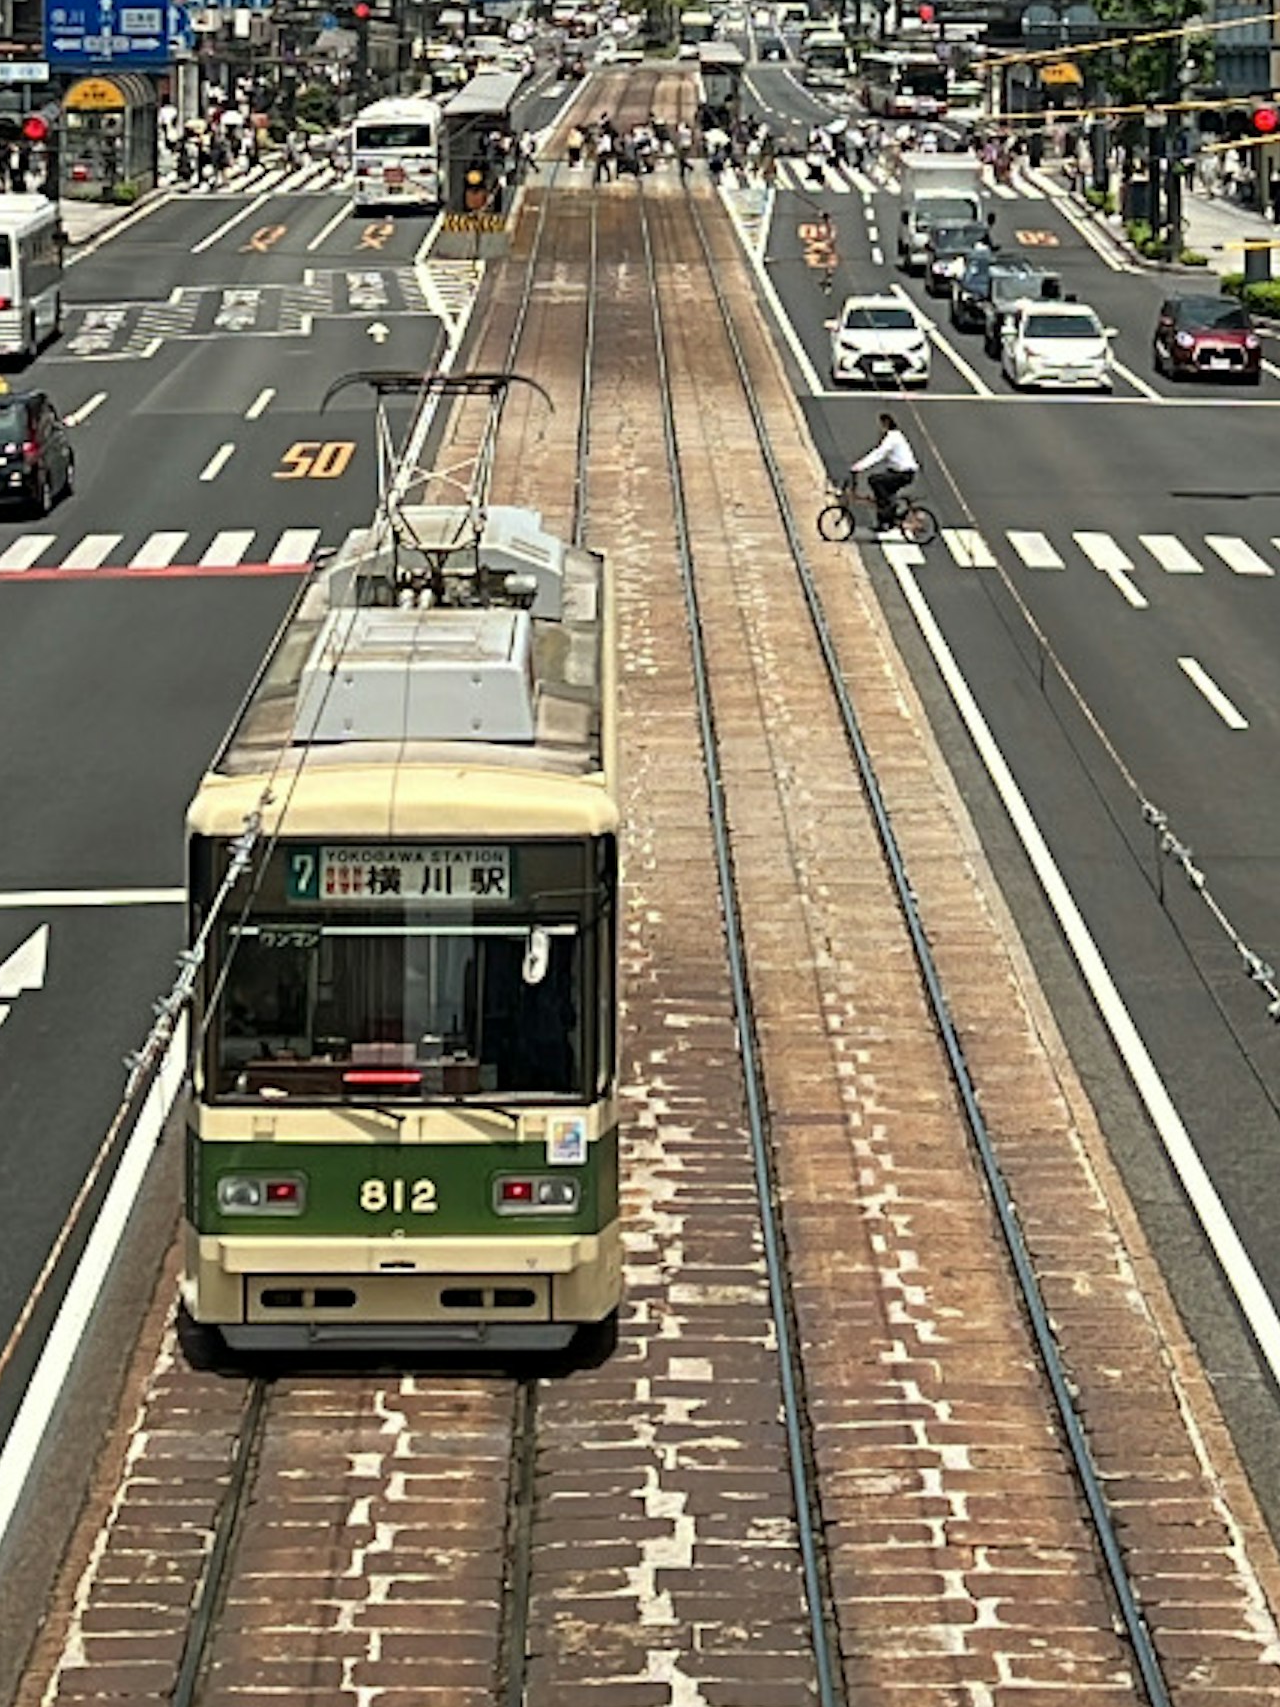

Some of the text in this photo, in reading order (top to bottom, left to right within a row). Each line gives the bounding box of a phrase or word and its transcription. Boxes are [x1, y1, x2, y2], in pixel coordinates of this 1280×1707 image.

[271, 441, 357, 479] 50
[293, 854, 314, 893] 7
[326, 849, 504, 863] YOKOGAWA STATION
[365, 864, 505, 896] 横川駅
[360, 1178, 439, 1213] 812
